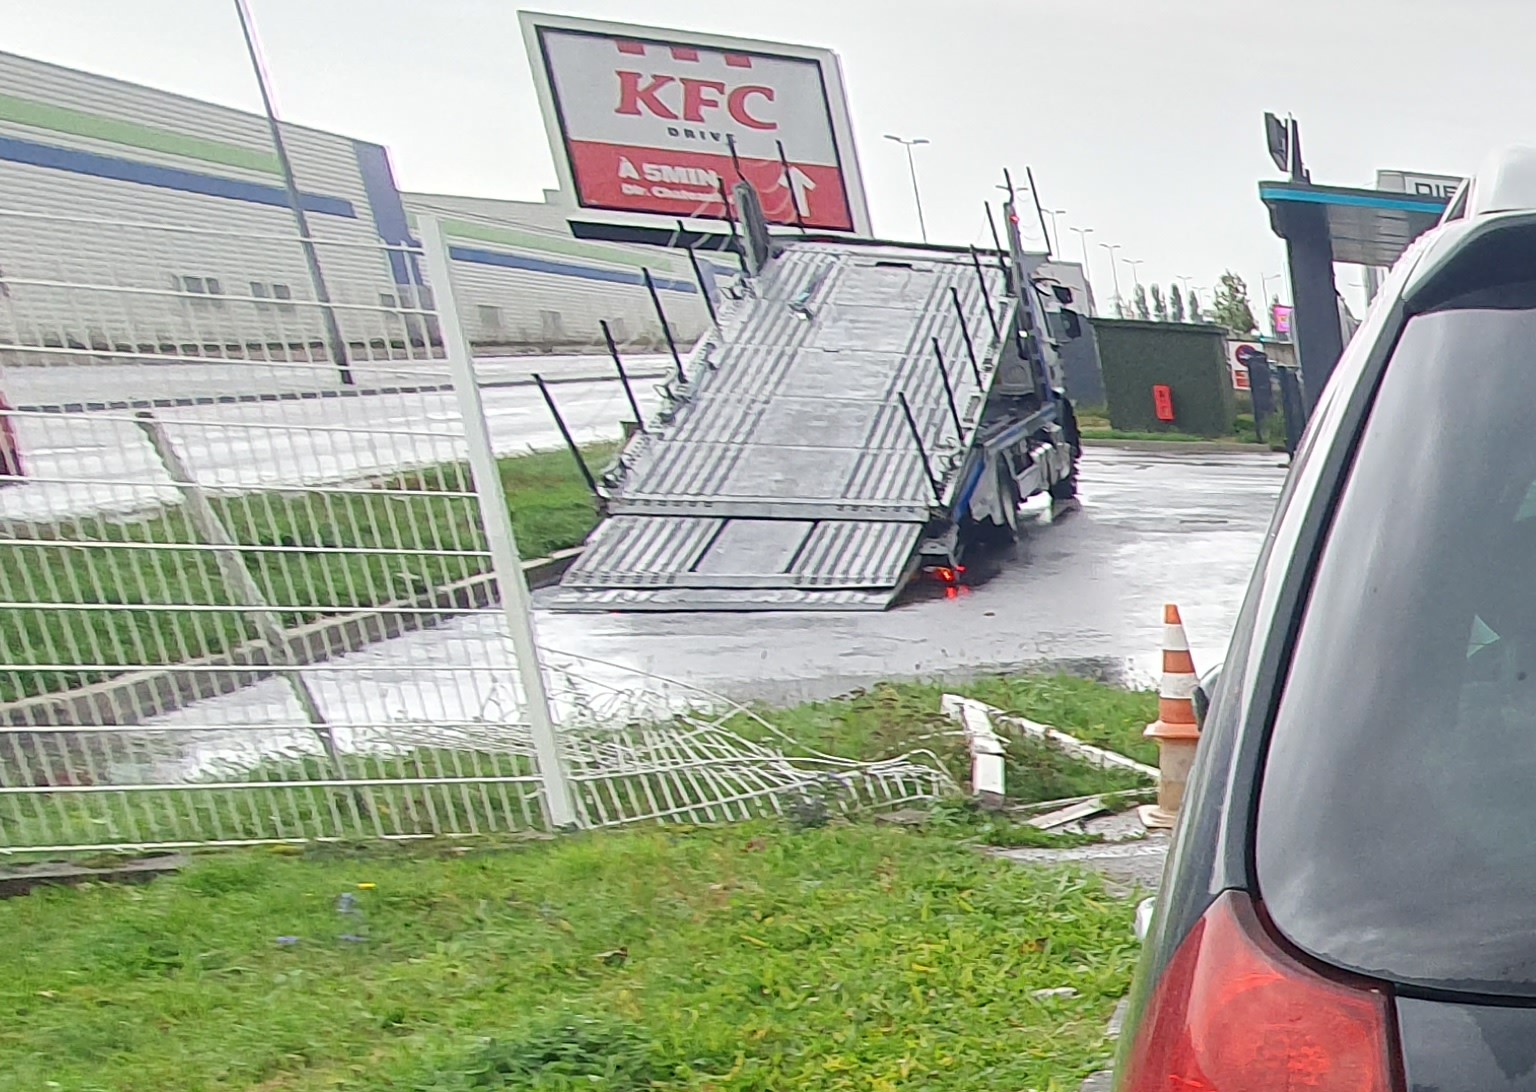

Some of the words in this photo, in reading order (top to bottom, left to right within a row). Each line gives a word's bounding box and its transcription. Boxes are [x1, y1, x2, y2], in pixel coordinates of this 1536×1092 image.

[614, 71, 778, 130] KFC
[667, 126, 736, 145] DRIVE
[642, 162, 719, 188] 5MIN
